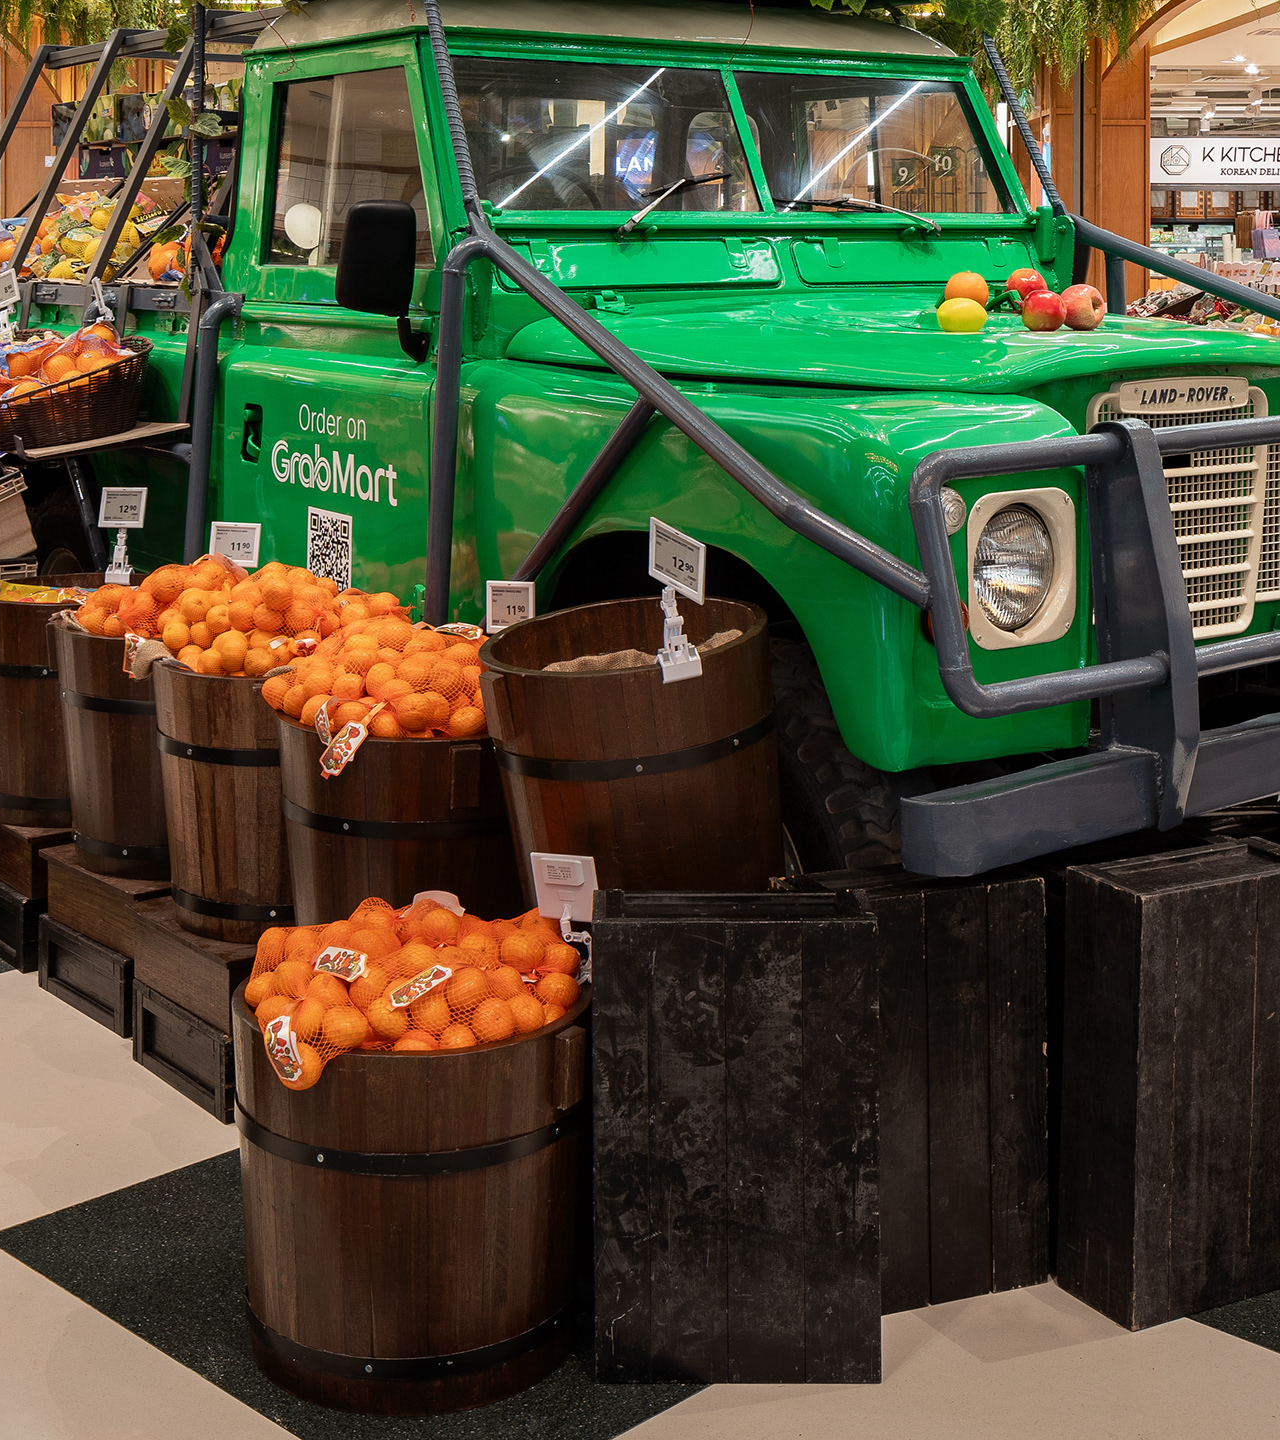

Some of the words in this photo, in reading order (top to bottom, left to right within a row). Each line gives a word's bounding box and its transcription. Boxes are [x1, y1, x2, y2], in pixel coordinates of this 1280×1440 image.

[1202, 147, 1215, 162] K
[934, 156, 952, 172] 10
[898, 167, 909, 181] 9
[1220, 168, 1257, 176] KOREAN
[1259, 168, 1280, 176] DELI
[299, 404, 342, 437] Order
[346, 417, 367, 441] on
[271, 440, 398, 507] GrabMart
